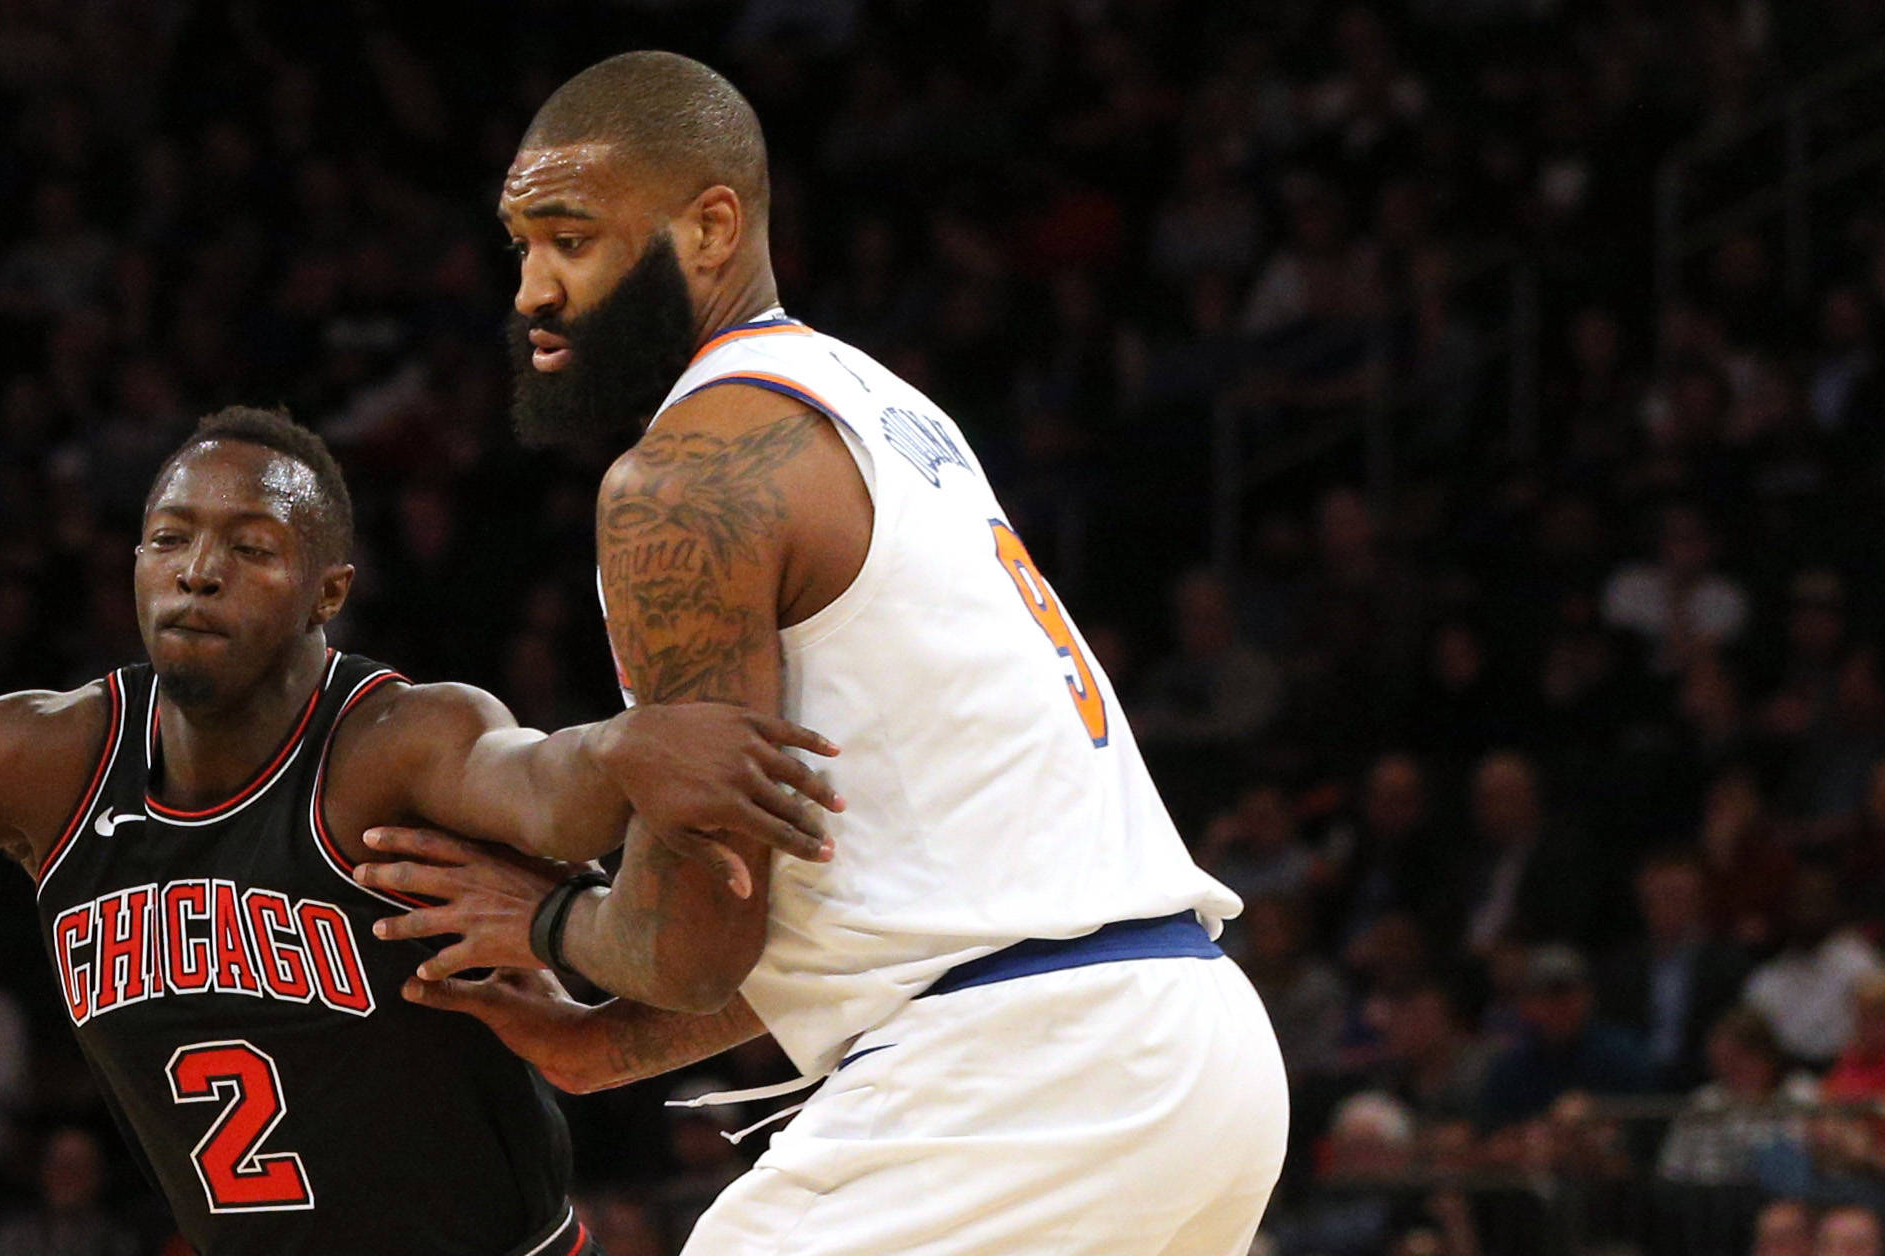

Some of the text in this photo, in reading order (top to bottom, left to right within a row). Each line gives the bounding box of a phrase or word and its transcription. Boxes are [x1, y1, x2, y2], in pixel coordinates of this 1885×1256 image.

[988, 518, 1108, 749] 9
[53, 878, 376, 1028] CHICAGO
[165, 1039, 315, 1214] 2
